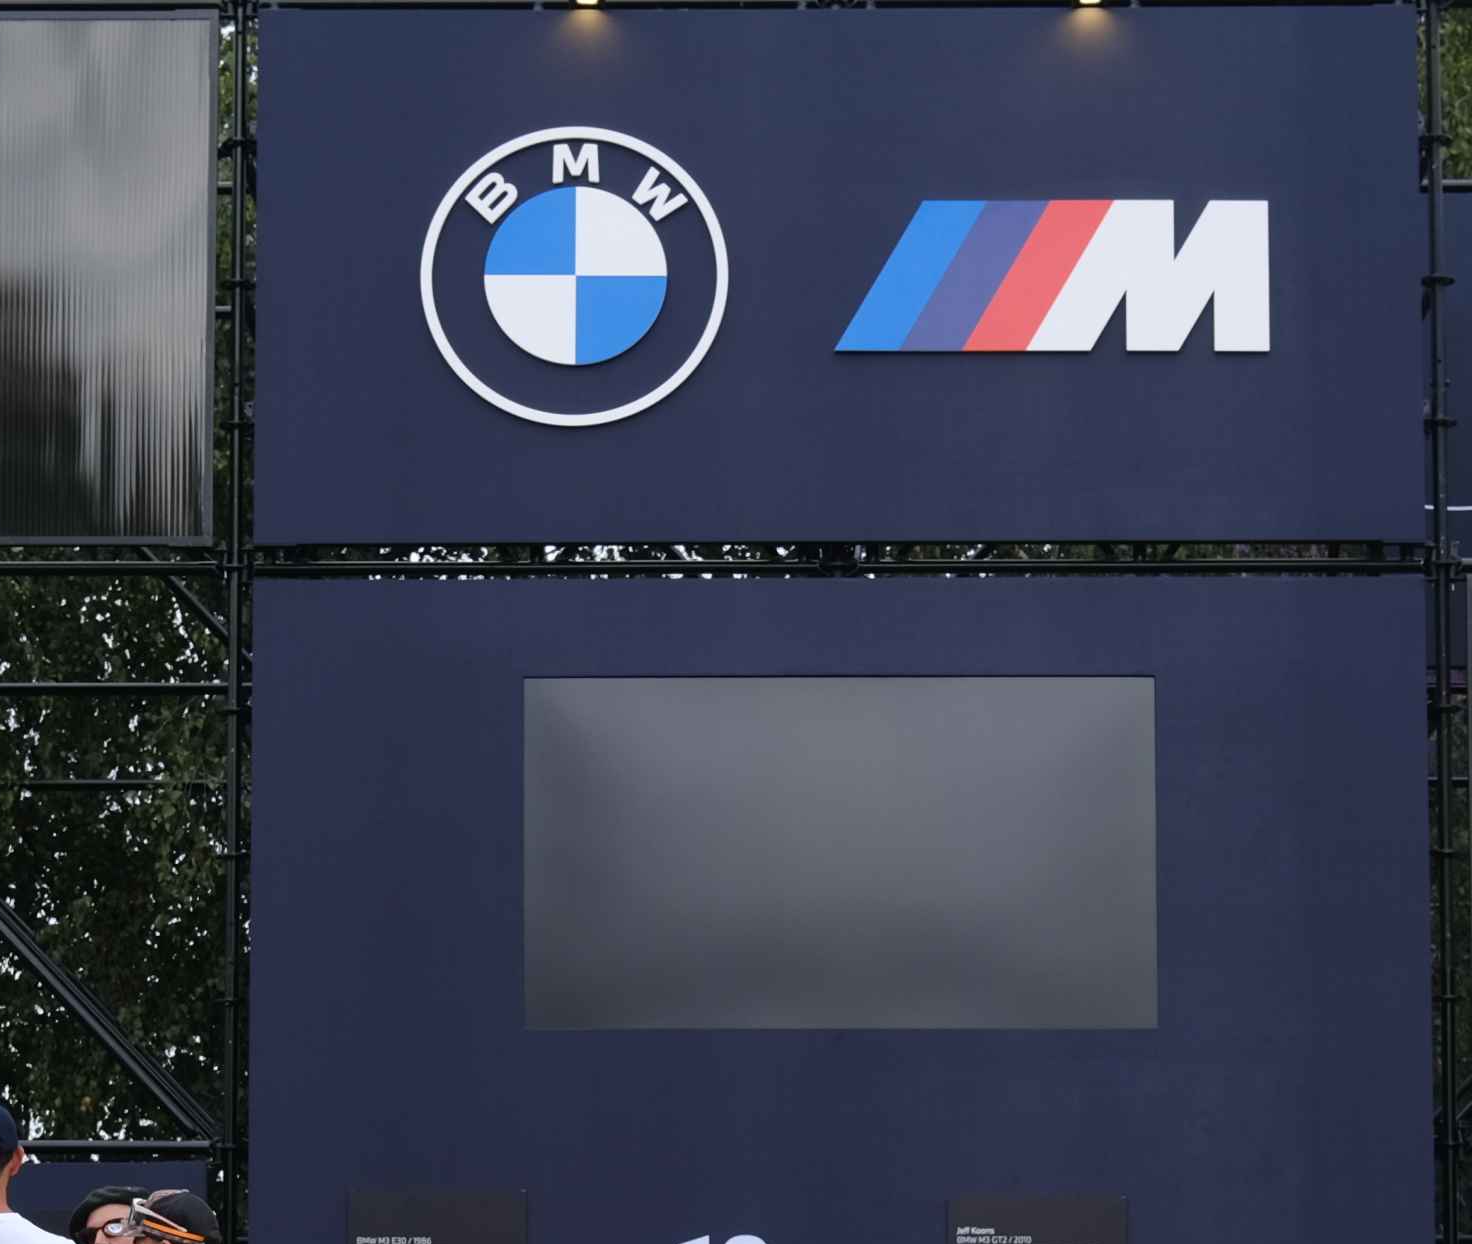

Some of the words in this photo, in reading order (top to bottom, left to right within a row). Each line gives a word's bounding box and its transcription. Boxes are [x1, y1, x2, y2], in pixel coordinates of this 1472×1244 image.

[464, 142, 688, 223] BMW
[956, 1227, 970, 1236] Jeff
[971, 1227, 995, 1235] Koons
[356, 1236, 377, 1244] BMW
[378, 1236, 390, 1244] M3
[391, 1236, 407, 1244] E30
[413, 1236, 432, 1244] 1986
[956, 1236, 977, 1244] BMW
[978, 1236, 990, 1244] M3
[991, 1236, 1008, 1244] GT2
